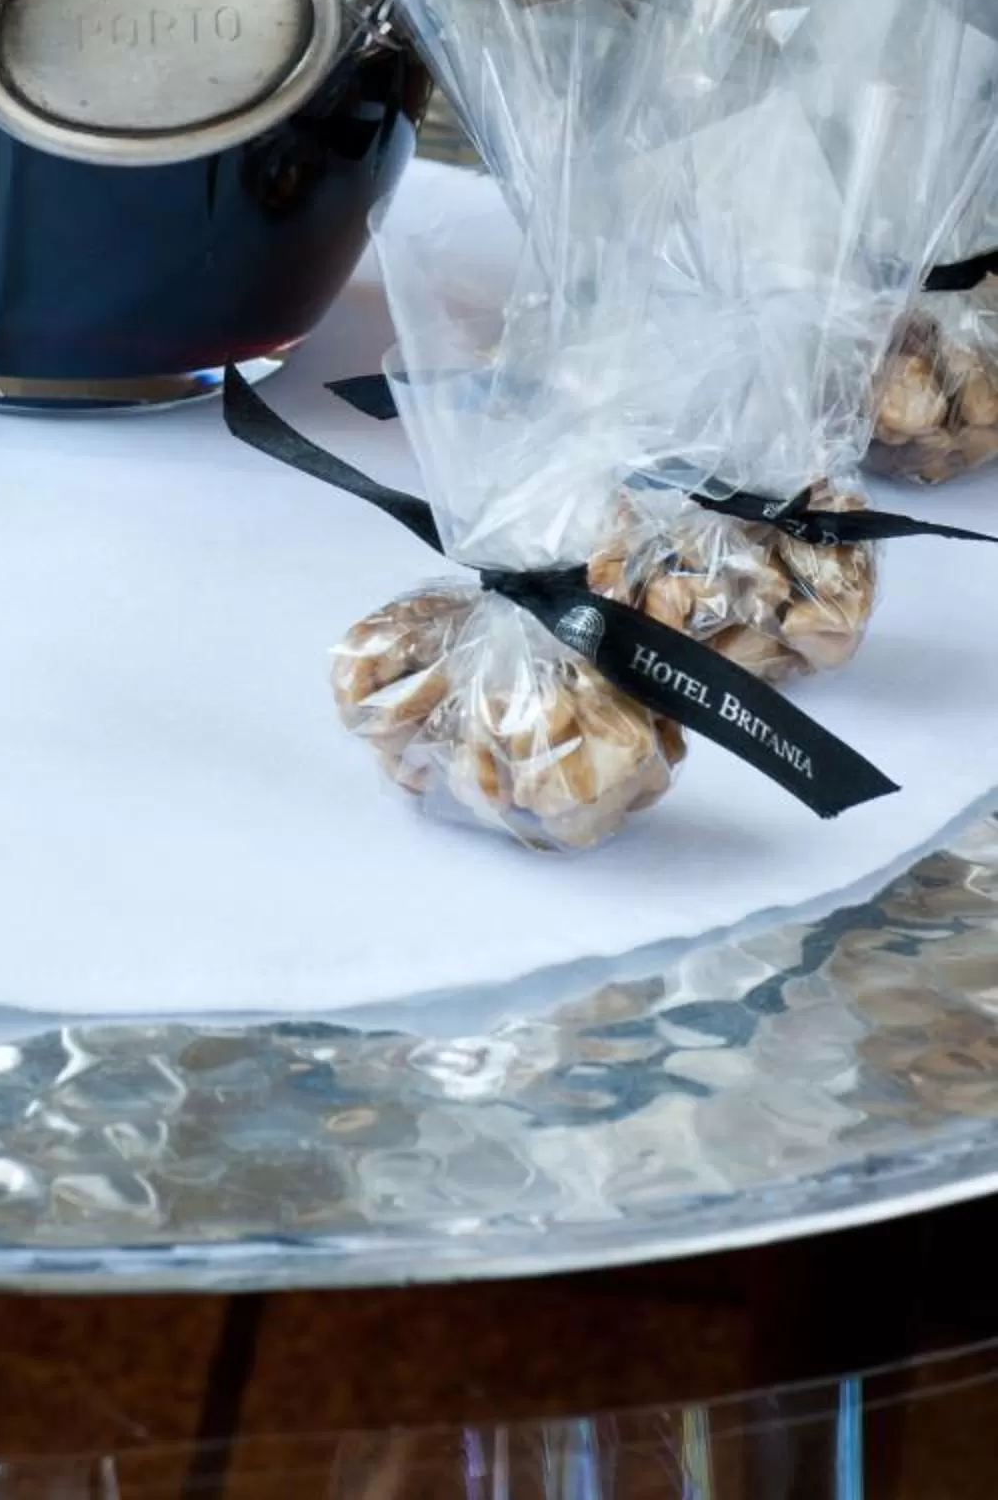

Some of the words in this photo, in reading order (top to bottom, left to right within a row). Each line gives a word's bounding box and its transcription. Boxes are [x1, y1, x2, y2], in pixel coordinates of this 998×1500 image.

[75, 5, 242, 51] PORTO
[629, 643, 711, 708] HOTEL
[719, 692, 814, 779] BRITANIA
